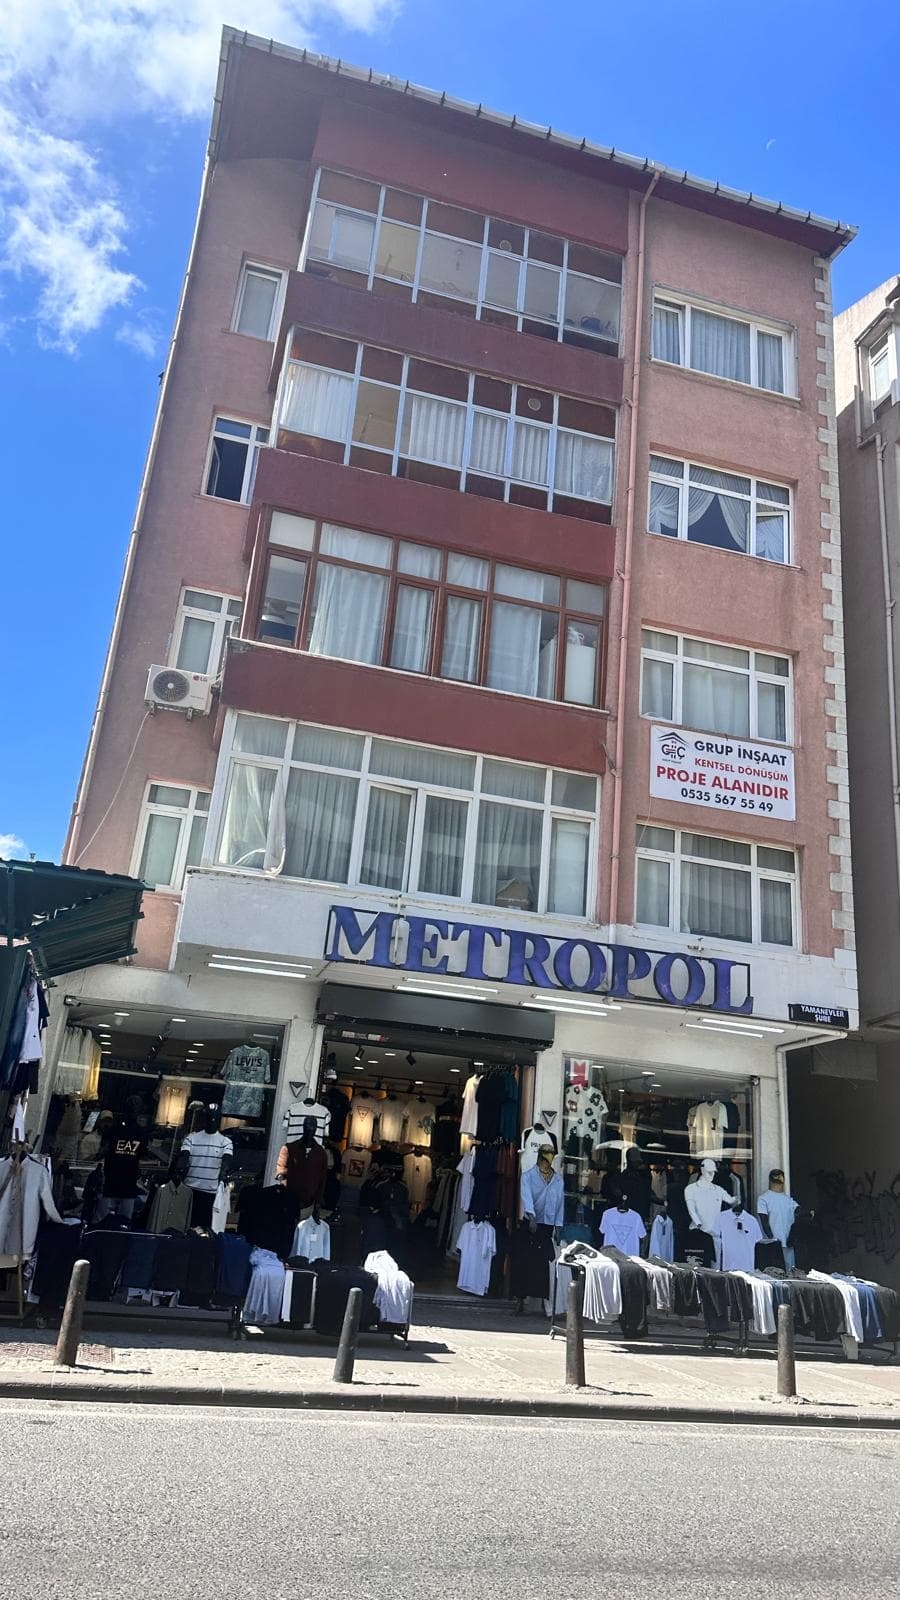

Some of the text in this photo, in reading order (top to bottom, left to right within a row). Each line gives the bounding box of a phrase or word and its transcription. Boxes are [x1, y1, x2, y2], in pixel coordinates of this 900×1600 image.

[694, 740, 787, 766] GRUP İNŞAAT
[694, 758, 789, 782] KENTSEL DÖNÜŞÜM
[656, 765, 789, 801] PROJE ALANIDIR
[681, 787, 774, 812] 0535 567 55 49
[326, 906, 754, 1015] METROPOL
[800, 1005, 845, 1018] YAMANEVLER
[235, 1056, 262, 1067] LEVI'S
[116, 1140, 141, 1152] EA7
